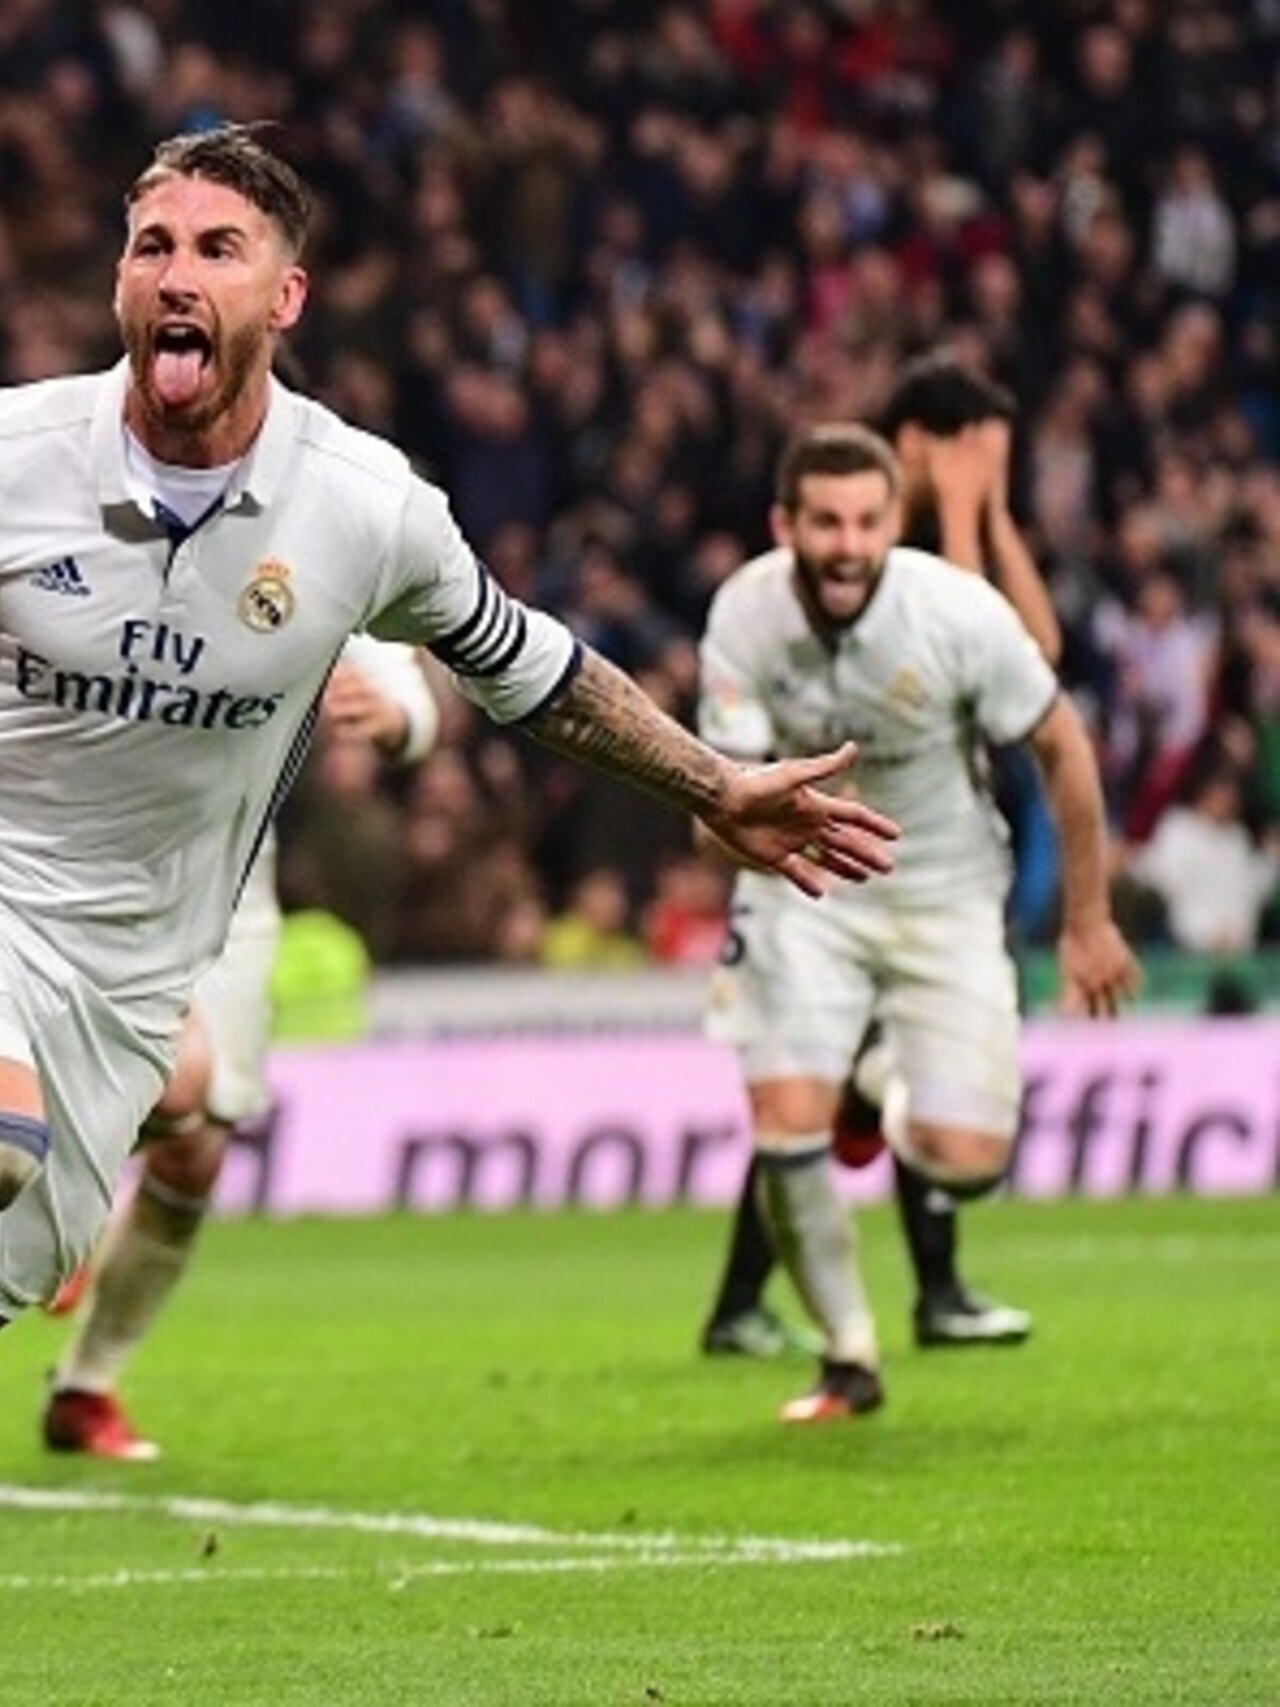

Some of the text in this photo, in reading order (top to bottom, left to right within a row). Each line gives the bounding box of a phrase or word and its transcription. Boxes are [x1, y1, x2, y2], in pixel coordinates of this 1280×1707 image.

[15, 645, 285, 731] Emirates
[119, 619, 205, 674] Fly
[394, 1120, 742, 1210] mor
